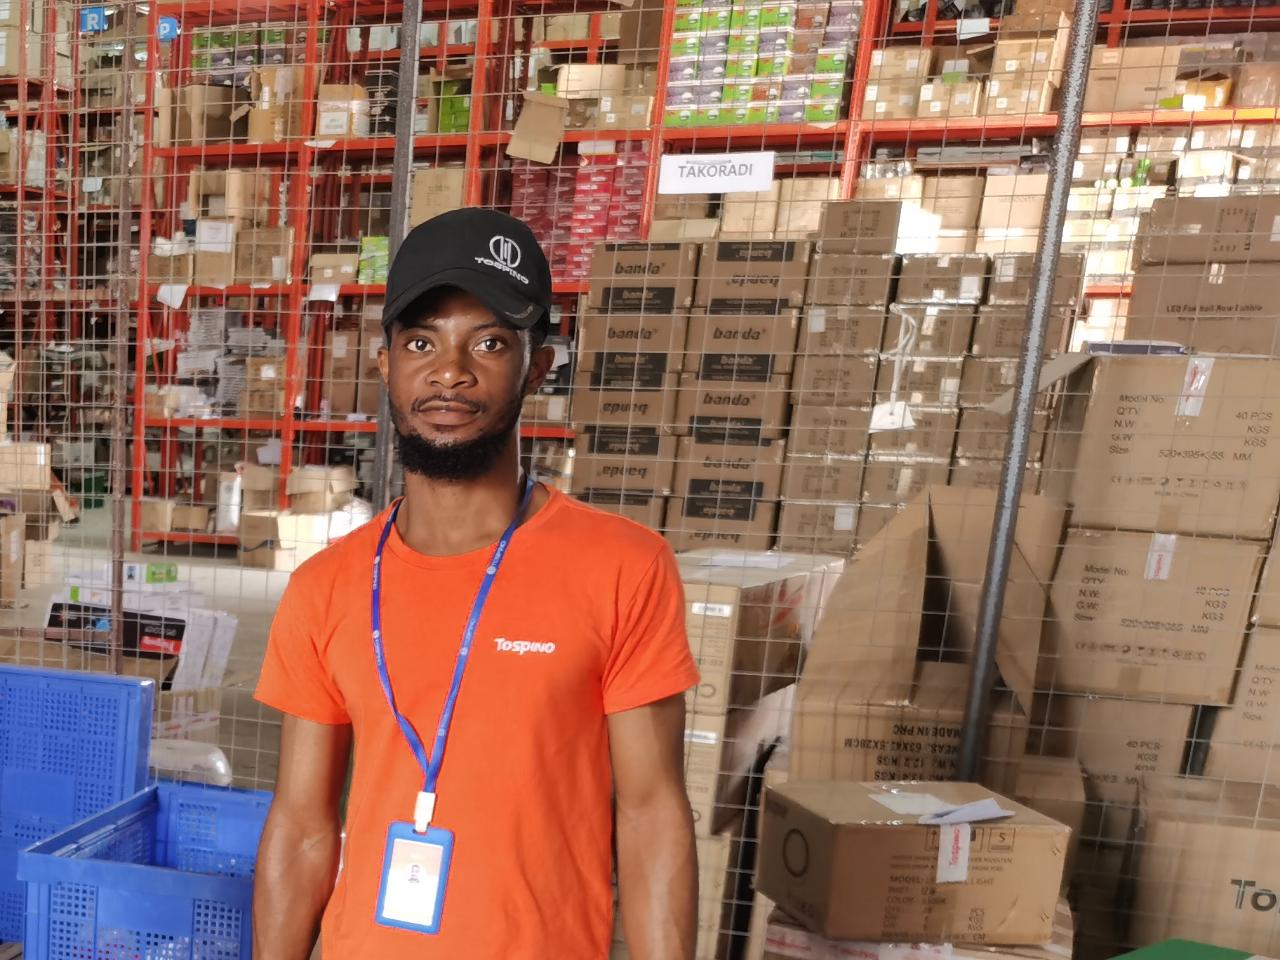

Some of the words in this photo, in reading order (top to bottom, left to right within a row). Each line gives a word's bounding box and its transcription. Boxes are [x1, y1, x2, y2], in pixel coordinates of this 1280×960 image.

[87, 13, 100, 30] R
[159, 22, 170, 40] P
[678, 163, 753, 179] TAKORADI
[615, 262, 661, 276] banda
[608, 328, 653, 340] banda
[704, 393, 750, 406] banda
[1231, 879, 1280, 911] To
